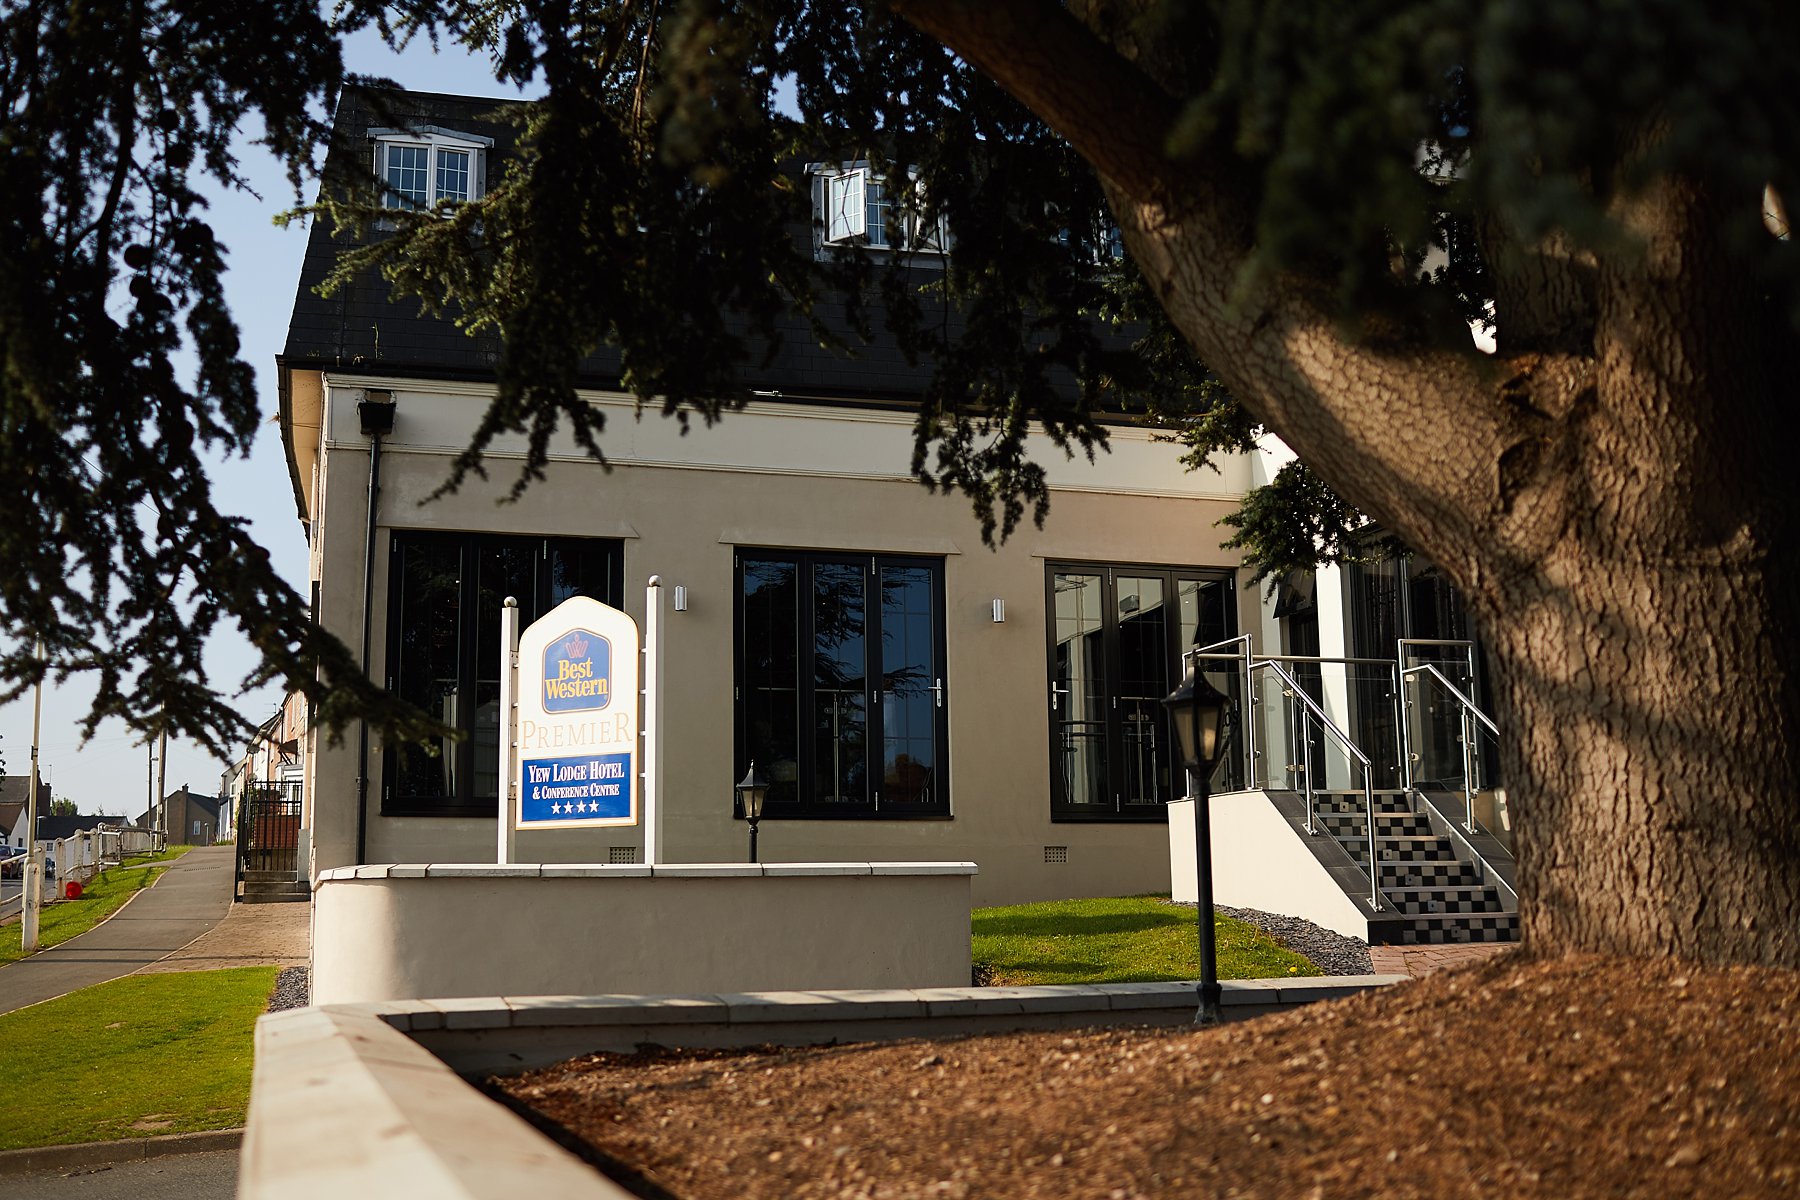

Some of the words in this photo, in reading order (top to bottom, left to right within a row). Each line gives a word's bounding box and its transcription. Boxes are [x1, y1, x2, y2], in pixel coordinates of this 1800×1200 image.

[558, 658, 593, 680] Best
[545, 678, 608, 699] Western
[521, 713, 632, 749] PREMIER
[528, 765, 550, 783] YEW
[553, 764, 586, 781] LODGE
[590, 761, 624, 780] HOTEL
[533, 786, 540, 800] &
[542, 786, 588, 799] CONFERENCE
[590, 783, 619, 796] CENTRE
